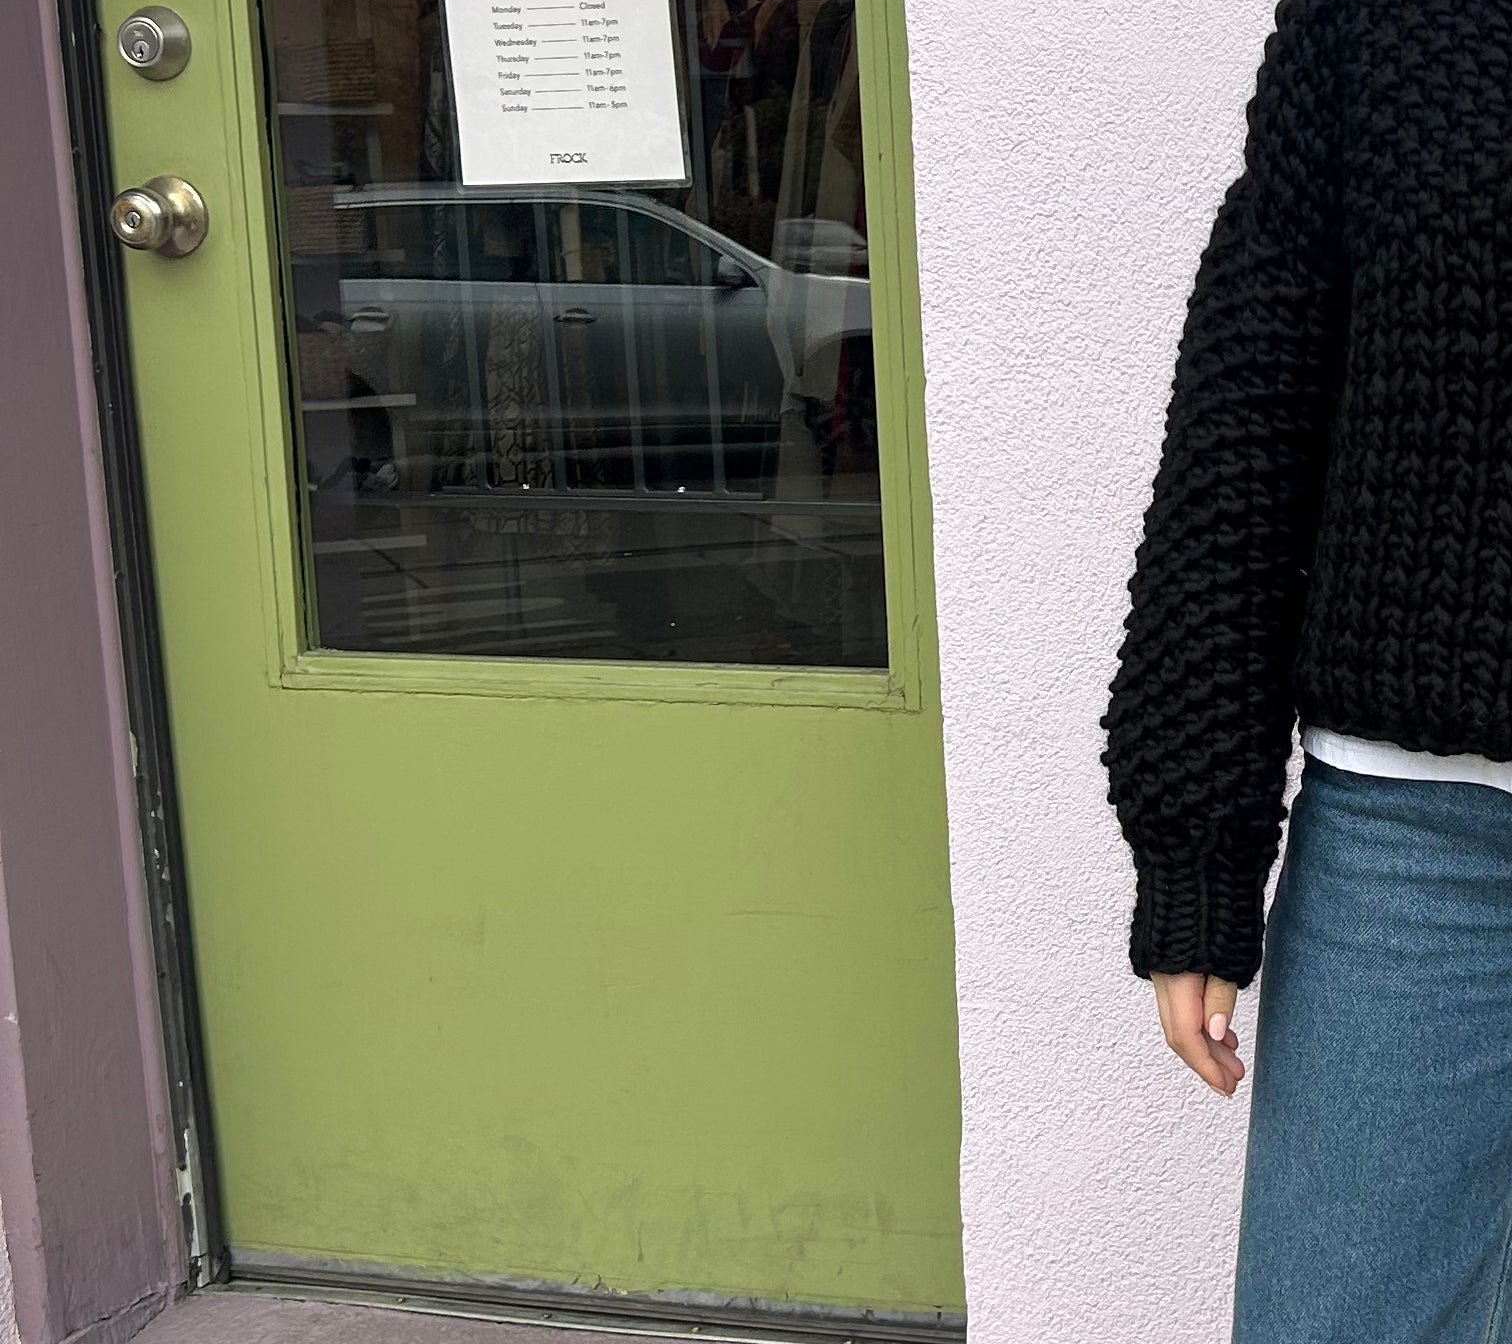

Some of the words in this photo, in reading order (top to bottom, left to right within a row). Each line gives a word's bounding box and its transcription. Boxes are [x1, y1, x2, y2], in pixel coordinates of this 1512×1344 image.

[491, 5, 522, 14] Monday
[579, 1, 606, 10] Closed
[493, 21, 523, 31] Tuesday
[581, 18, 619, 27] 11am-7pm
[494, 38, 538, 47] Wednesday
[582, 34, 620, 44] 11am-7pm
[496, 54, 530, 64] Thursday
[583, 51, 622, 60] 11am-7pm
[498, 71, 521, 81] Friday
[585, 67, 623, 77] 11am-7pm
[500, 87, 532, 97] Saturday
[501, 104, 528, 113] Sunday
[549, 152, 589, 164] FROCK
